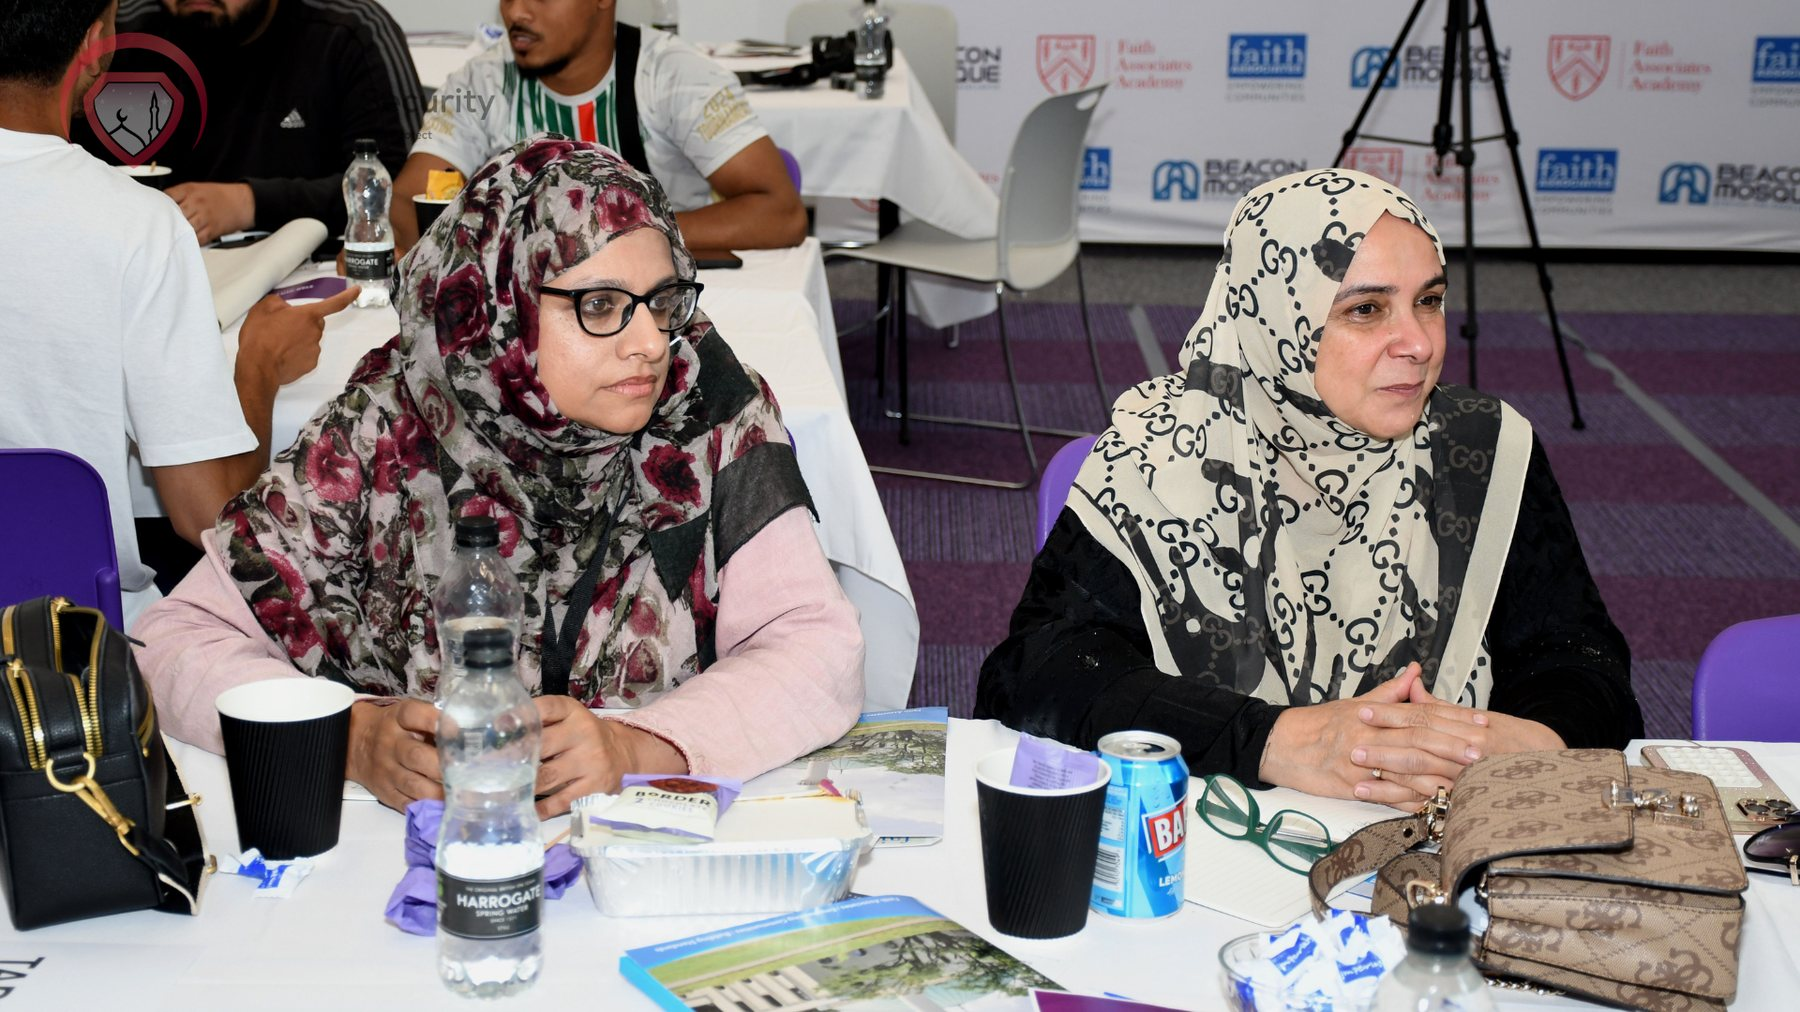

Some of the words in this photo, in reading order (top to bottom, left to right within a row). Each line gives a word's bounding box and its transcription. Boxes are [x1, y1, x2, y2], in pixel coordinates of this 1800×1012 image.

[1118, 39, 1156, 54] Faith
[1231, 38, 1305, 67] faith
[1633, 40, 1674, 56] Faith
[1118, 57, 1193, 72] Associates
[1632, 59, 1712, 74] Associates
[1118, 74, 1185, 91] Academy
[1632, 76, 1704, 93] Academy
[1204, 160, 1308, 177] BEACON
[1540, 153, 1615, 181] faith
[635, 791, 711, 807] BORDER
[456, 884, 541, 909] HARROGATE
[475, 909, 504, 918] SPRING
[506, 904, 529, 915] WATER
